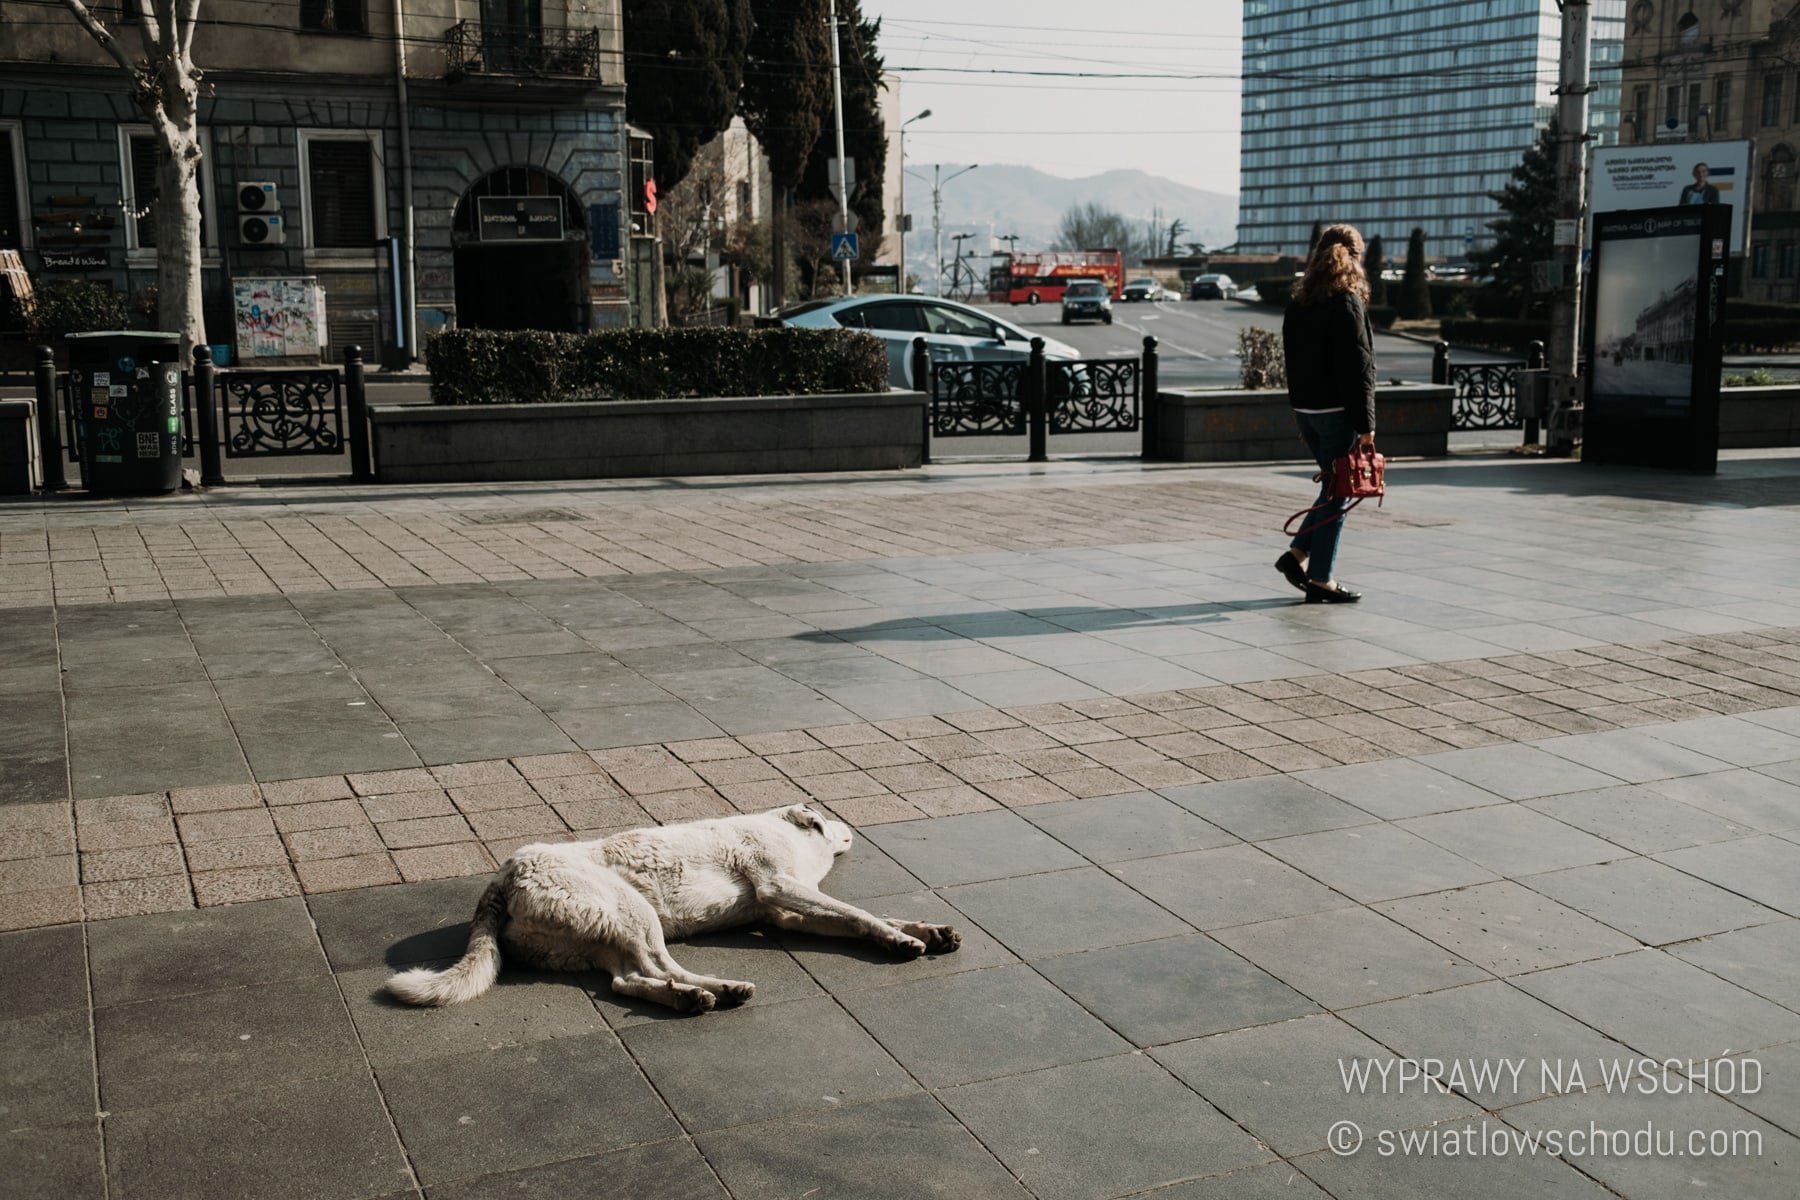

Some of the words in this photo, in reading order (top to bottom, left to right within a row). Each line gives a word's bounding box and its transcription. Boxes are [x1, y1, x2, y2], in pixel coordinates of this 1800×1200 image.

[44, 256, 74, 267] Bread
[81, 257, 107, 265] Wine
[138, 433, 158, 444] BNE
